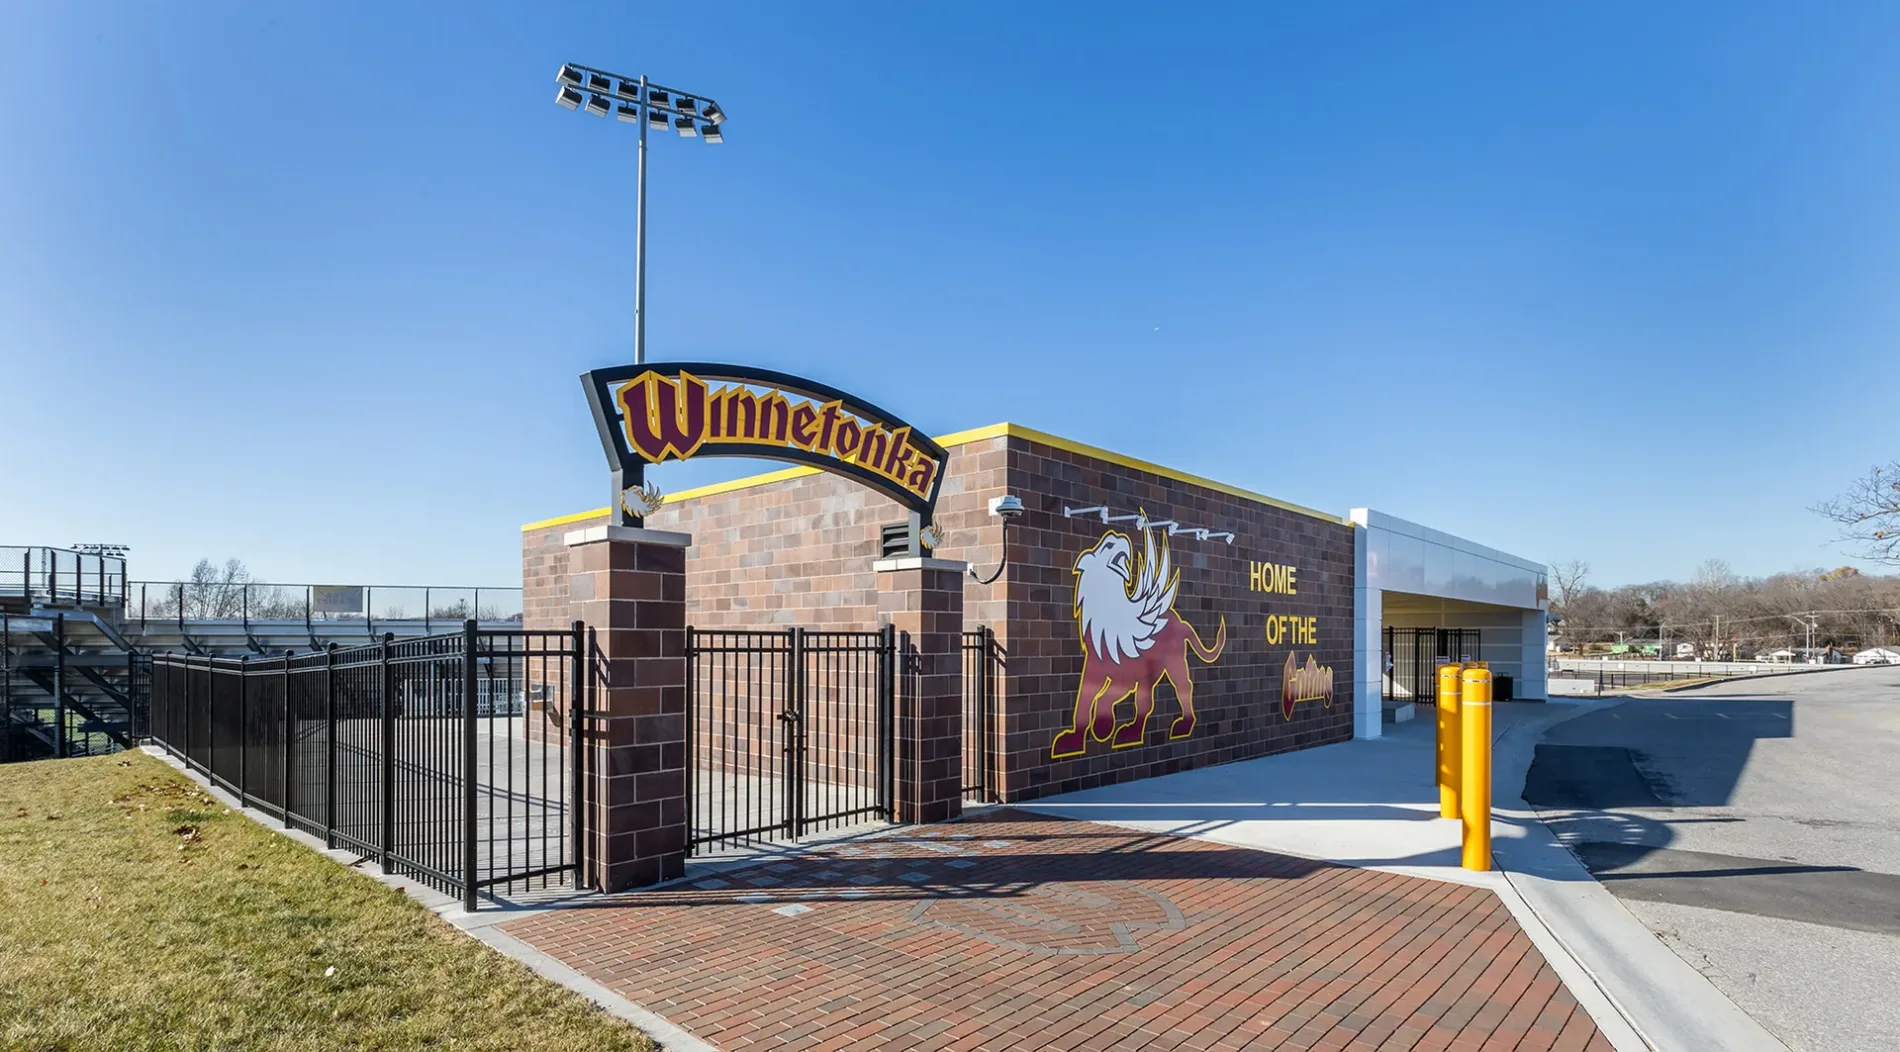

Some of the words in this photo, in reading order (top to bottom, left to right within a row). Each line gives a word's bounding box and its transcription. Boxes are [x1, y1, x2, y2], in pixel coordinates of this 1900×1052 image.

[616, 370, 937, 498] Winnetonka
[1249, 561, 1297, 595] HOME
[1265, 615, 1287, 645] OF
[1289, 616, 1317, 645] THE
